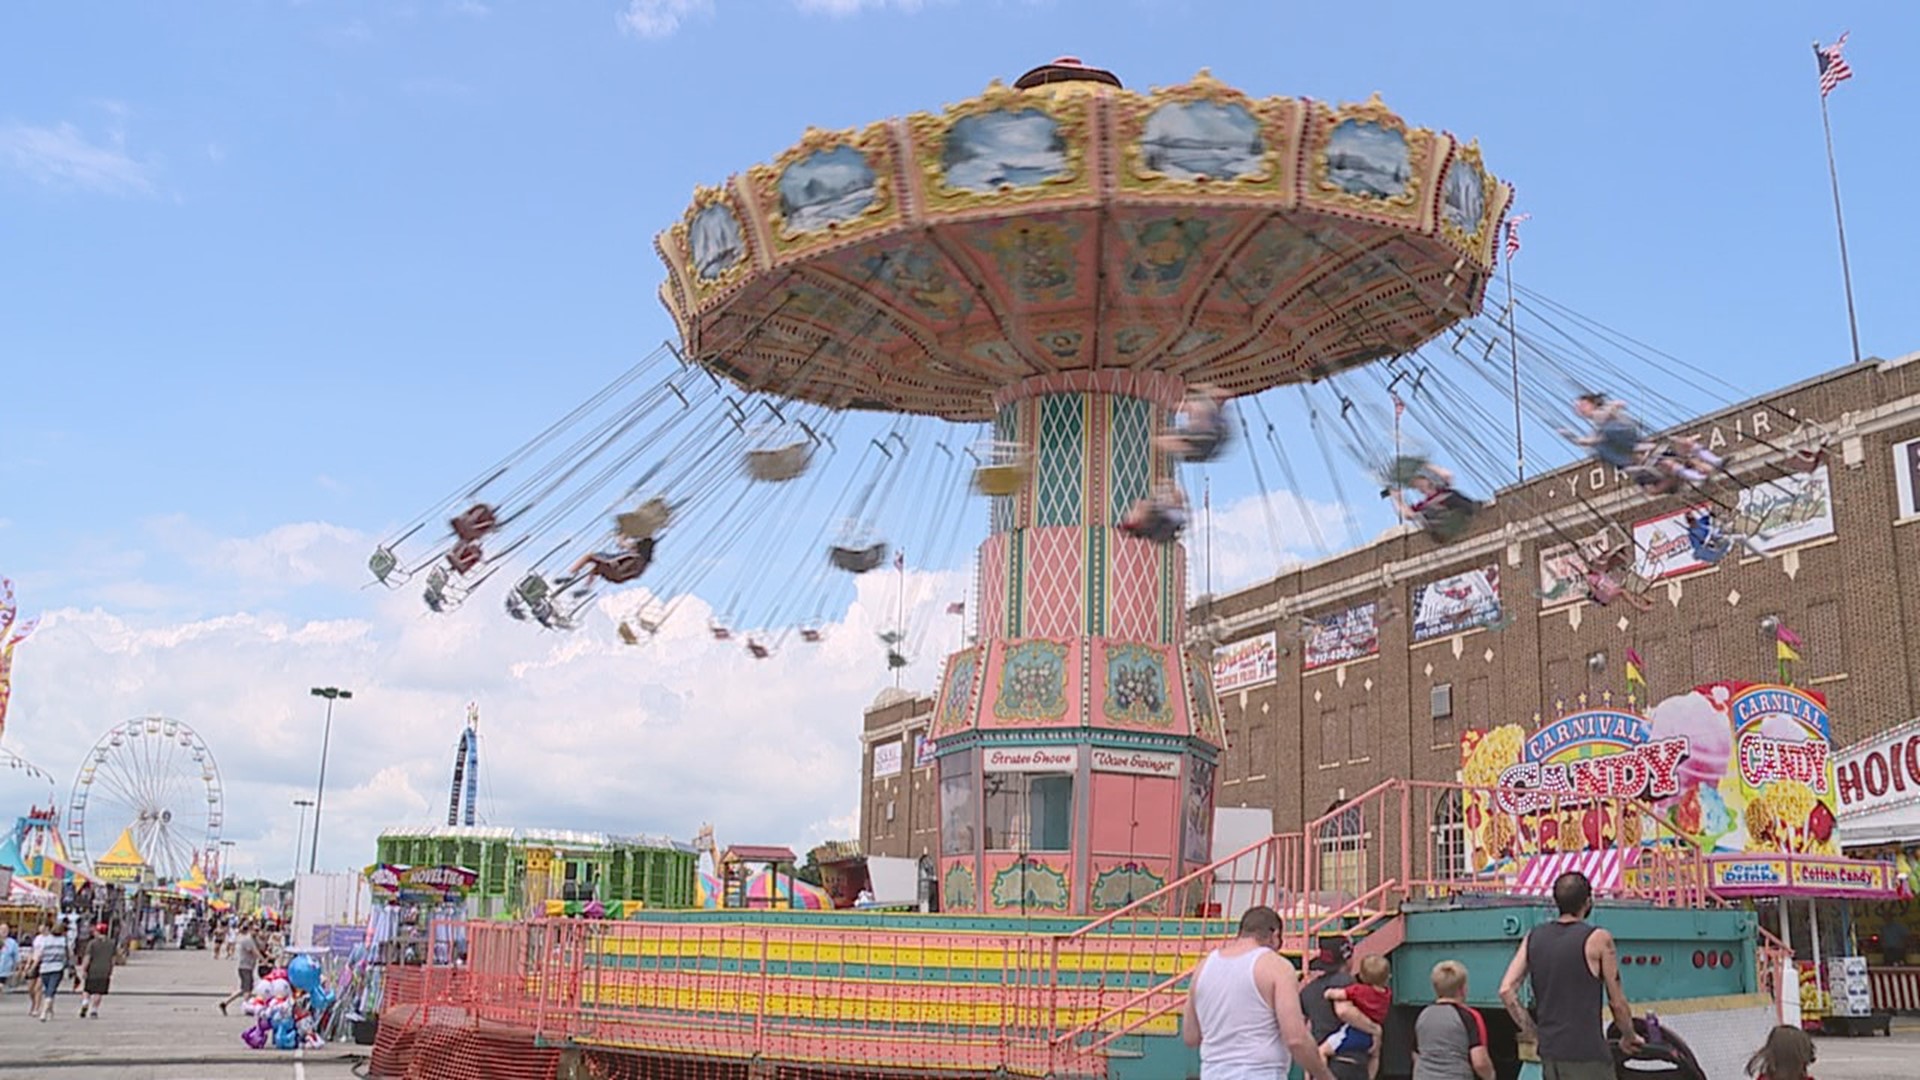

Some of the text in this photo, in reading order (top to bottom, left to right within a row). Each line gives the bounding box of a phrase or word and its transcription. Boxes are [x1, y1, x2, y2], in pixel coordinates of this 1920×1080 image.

[1690, 410, 1771, 451] AIR
[1566, 466, 1629, 497] YOR
[1739, 696, 1823, 728] CARNIVAL
[1530, 720, 1641, 758] CARNIVAL
[991, 750, 1071, 765] Strates Shows
[1130, 754, 1175, 772] Swinger
[1739, 734, 1829, 794] CANDY
[1497, 737, 1689, 814] CANDY
[409, 868, 464, 886] NOVELTIES
[1726, 871, 1778, 883] Drinks
[1802, 865, 1872, 885] Cotton Candy
